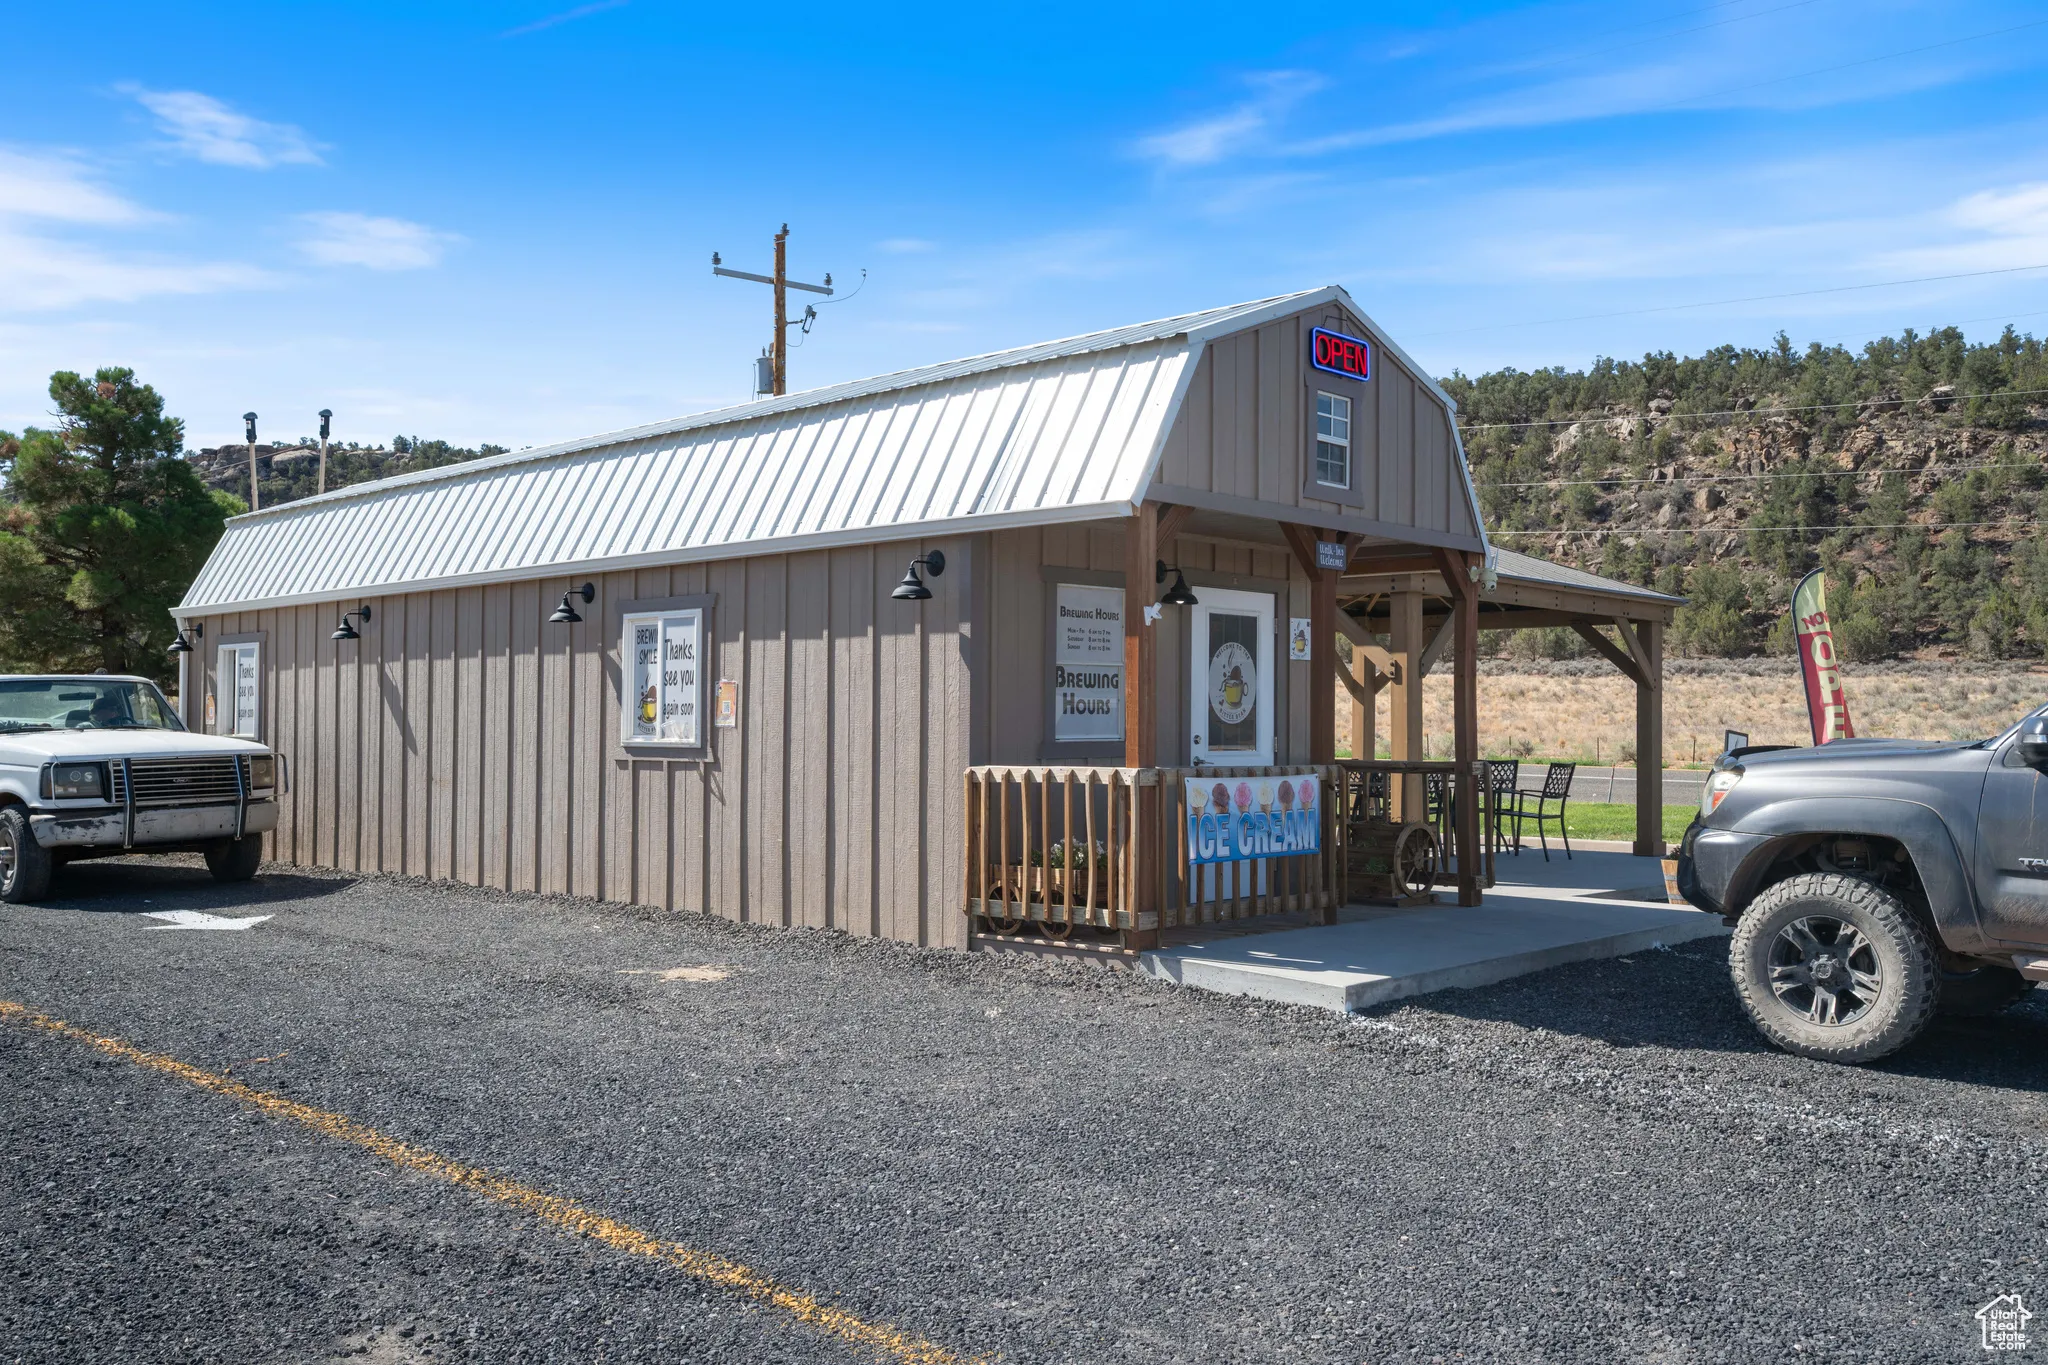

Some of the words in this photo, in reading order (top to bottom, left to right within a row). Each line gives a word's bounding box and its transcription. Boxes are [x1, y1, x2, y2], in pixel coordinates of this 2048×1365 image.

[1316, 334, 1367, 375] OPEN
[664, 638, 695, 662] Thanks,
[664, 669, 678, 687] see
[680, 669, 695, 693] you
[662, 699, 679, 720] again
[1189, 812, 1230, 860] ICE
[1237, 808, 1316, 856] CREAM
[2018, 857, 2048, 867] TA
